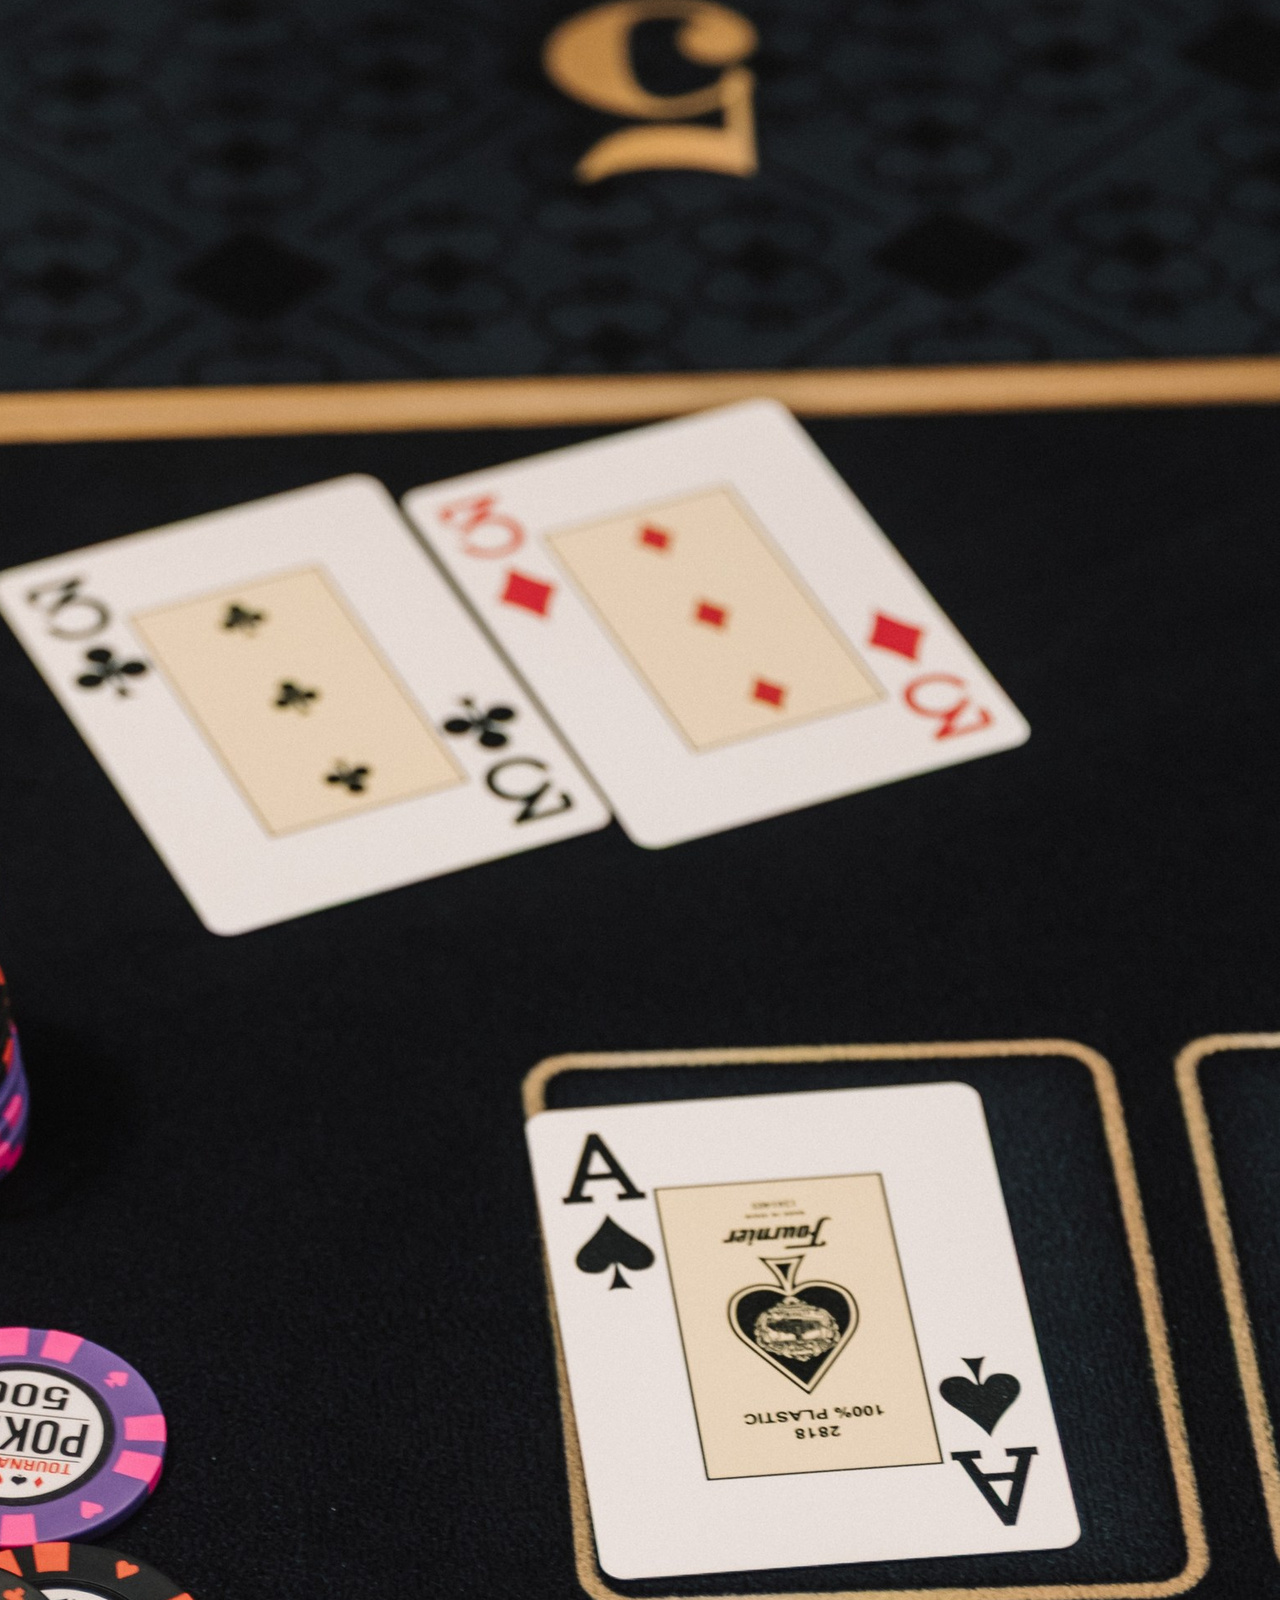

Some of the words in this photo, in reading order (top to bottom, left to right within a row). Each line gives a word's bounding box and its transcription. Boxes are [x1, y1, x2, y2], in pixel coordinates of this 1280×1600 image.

[542, 0, 759, 184] 5
[438, 492, 525, 560] 3
[26, 573, 111, 645] 3
[900, 670, 995, 741] 3
[484, 756, 576, 827] 3
[562, 1133, 646, 1204] A
[723, 1216, 831, 1249] Fournier
[744, 1408, 828, 1425] PLASTIC
[794, 1425, 841, 1439] 2818
[834, 1404, 885, 1419] 100%
[951, 1446, 1038, 1526] A
